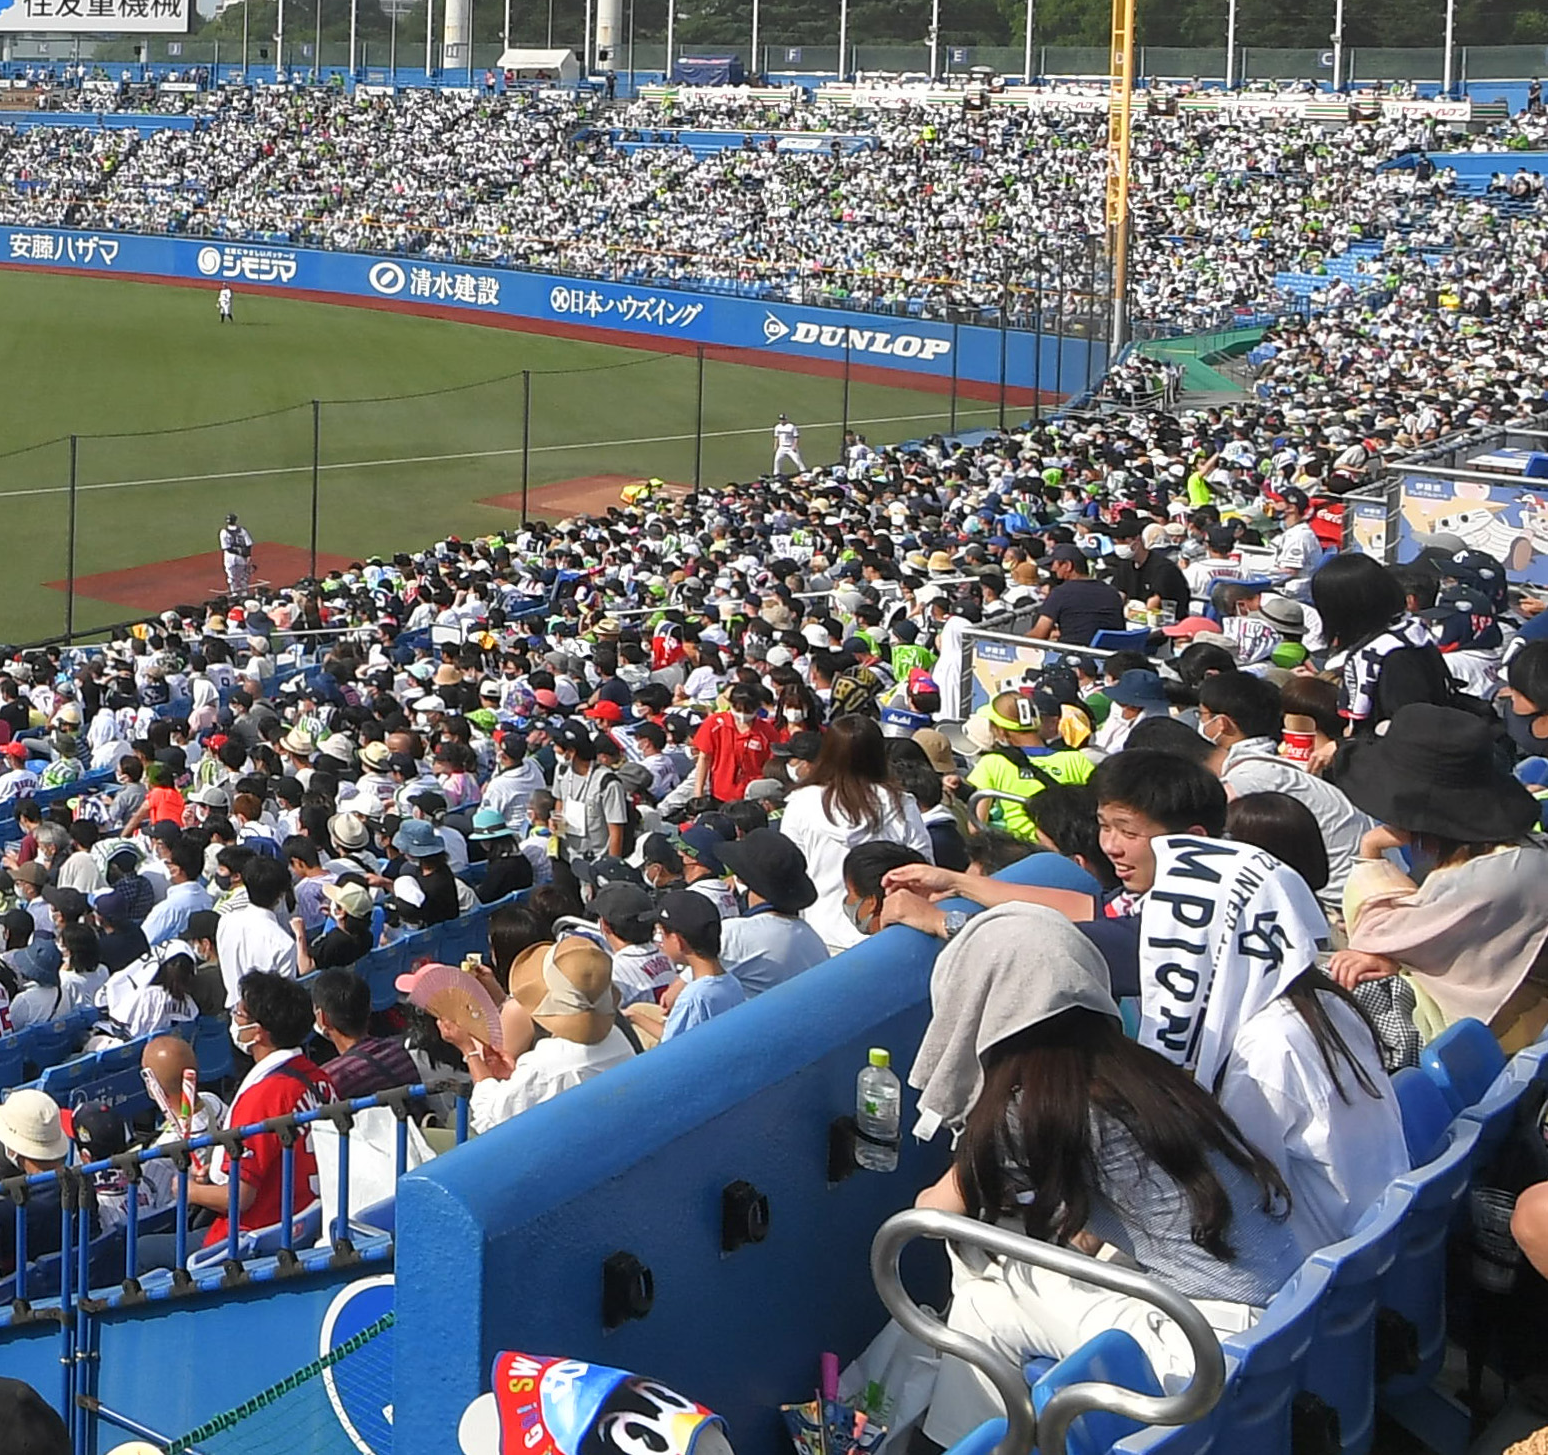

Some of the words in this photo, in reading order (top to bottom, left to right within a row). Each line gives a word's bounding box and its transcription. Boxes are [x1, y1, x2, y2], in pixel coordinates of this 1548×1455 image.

[9, 232, 120, 265] 安藤ハザマ
[222, 255, 297, 283] シモジマ
[409, 266, 501, 306] 清水建設
[570, 289, 704, 327] 日本ハウズイング
[789, 322, 952, 360] DUNLOP
